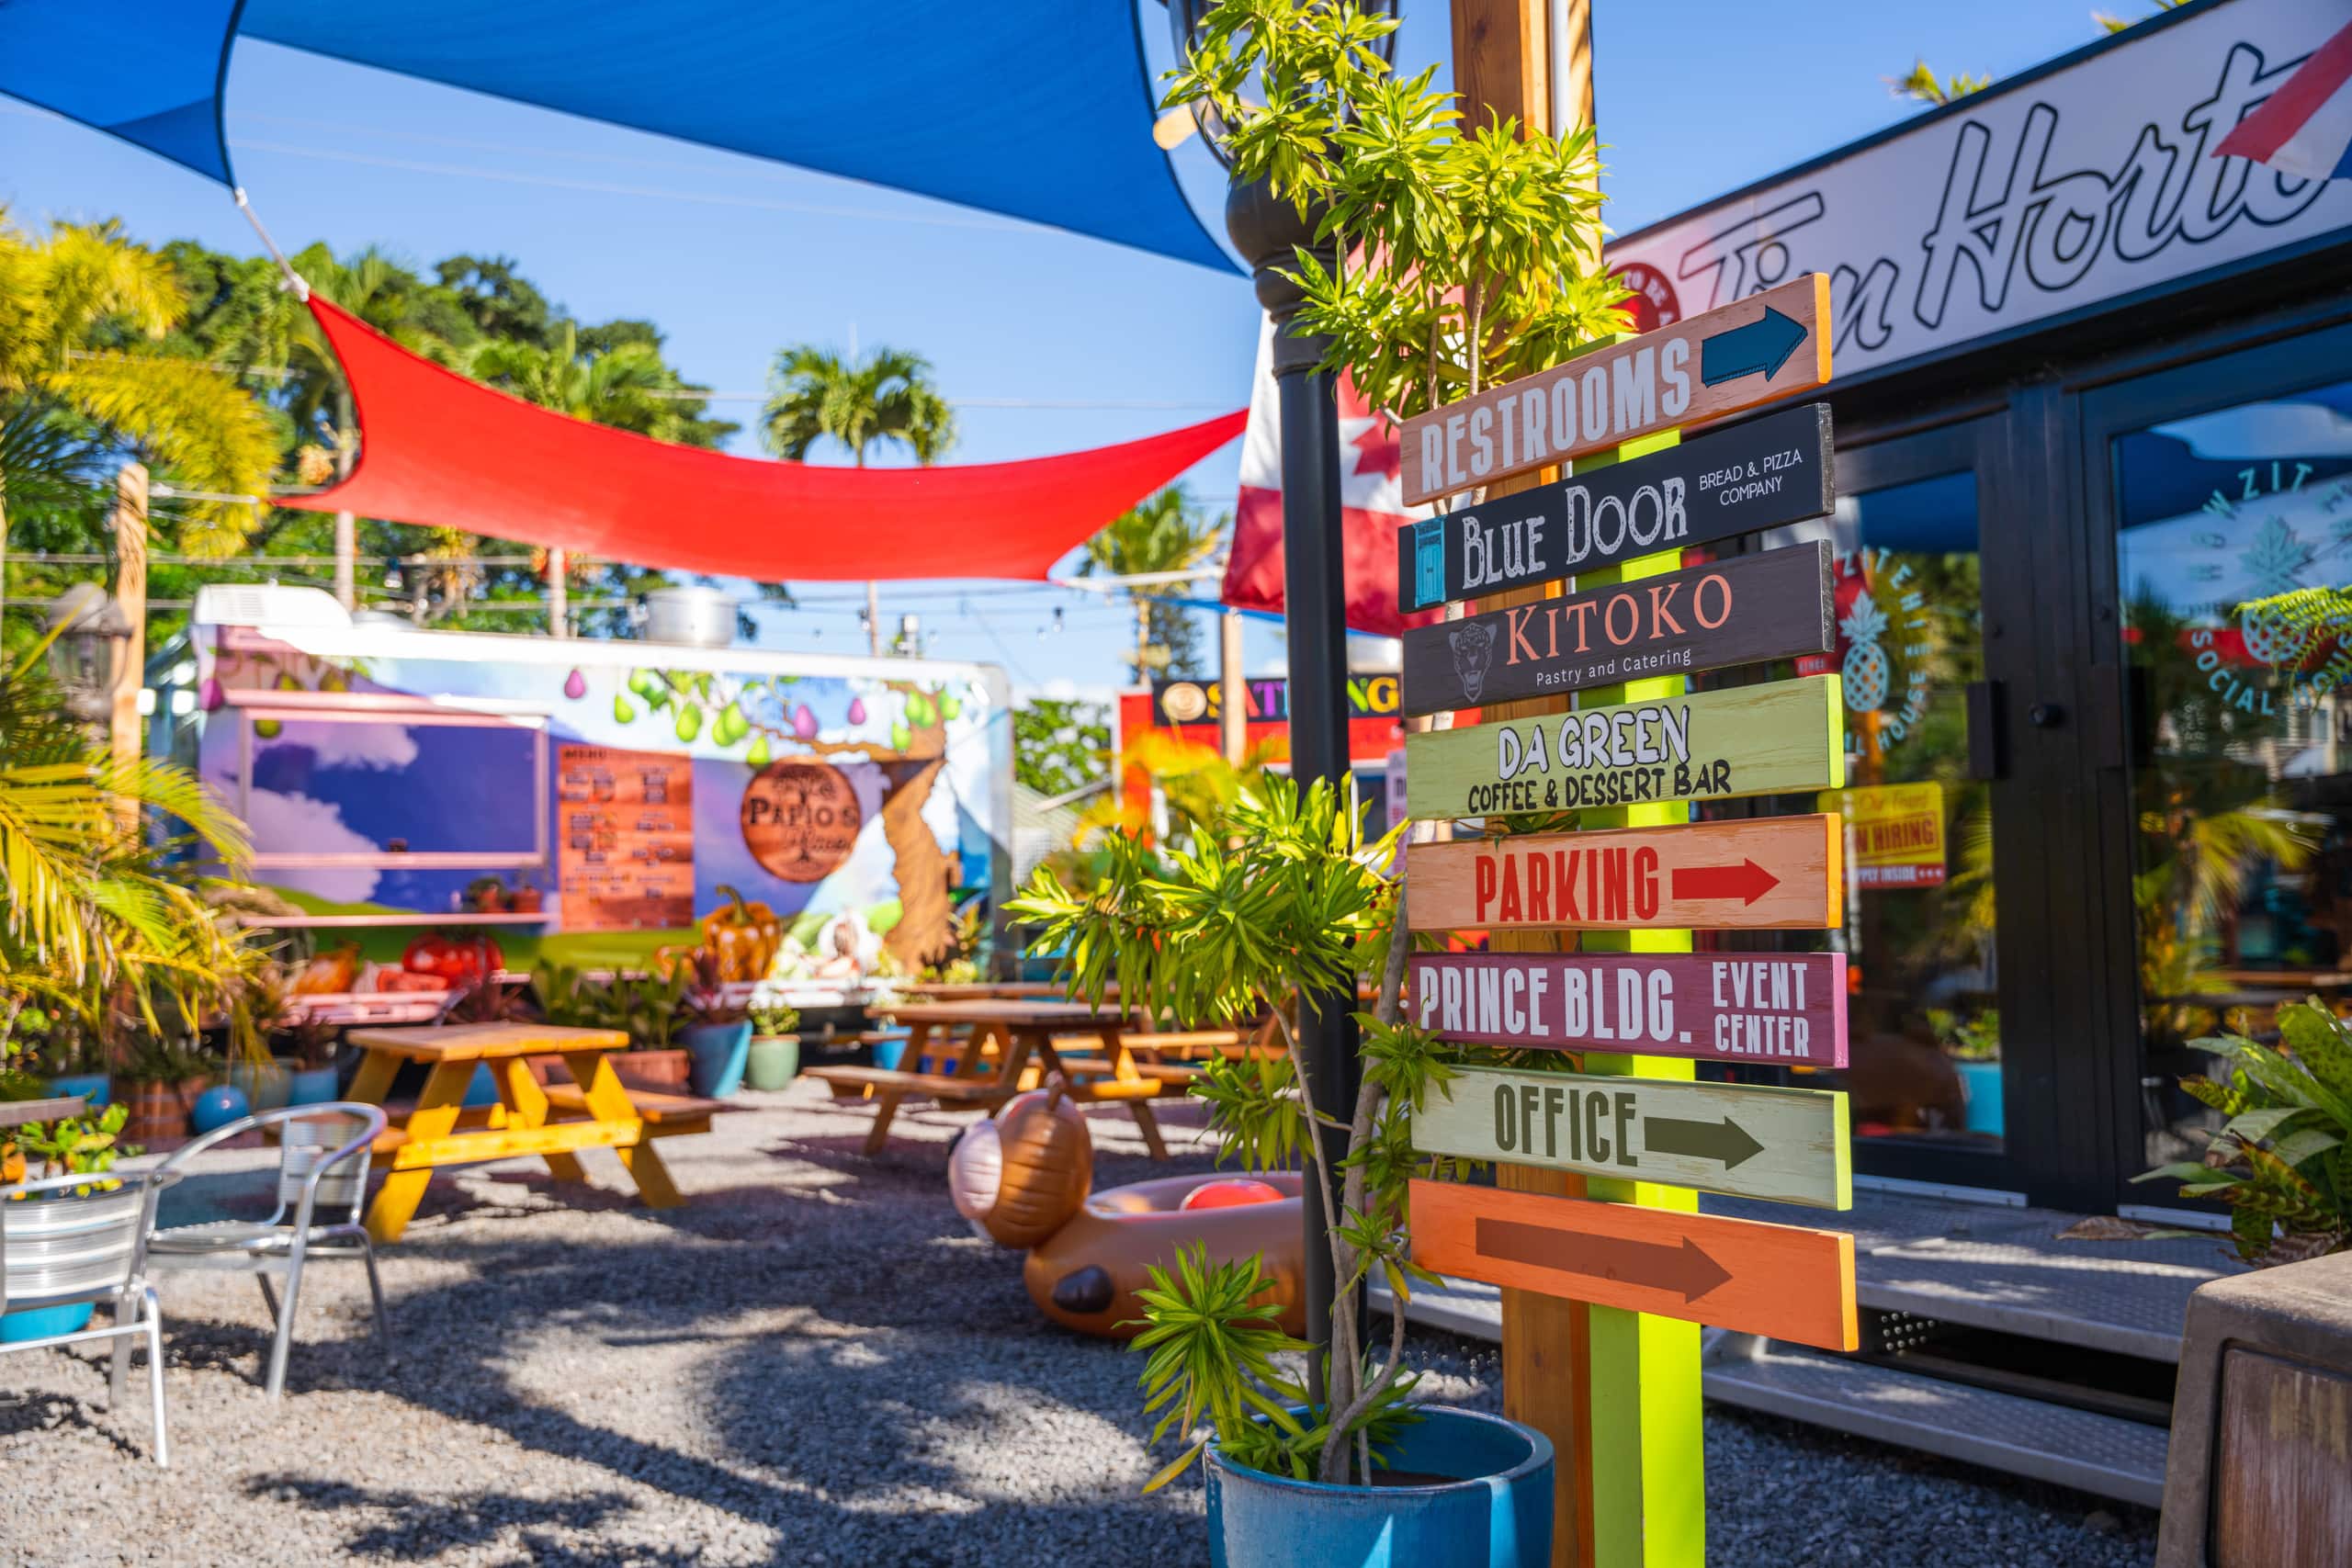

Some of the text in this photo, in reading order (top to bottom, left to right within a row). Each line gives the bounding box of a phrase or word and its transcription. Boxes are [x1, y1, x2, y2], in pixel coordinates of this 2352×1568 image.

[1420, 336, 1690, 494] RESTROOMS
[1699, 447, 1804, 491] BREAD & PIZZA
[1720, 475, 1783, 506] COMPANY
[1566, 475, 1689, 566] DOOR
[1504, 574, 1732, 665] KITOKO
[1536, 648, 1692, 687] Pastry and Catering
[2192, 631, 2276, 716] SOCIAL
[1498, 705, 1690, 781] DA GREEN
[1876, 671, 1927, 750] HOUSE
[1469, 759, 1732, 815] COFFEE & DESSERT BAR
[1873, 818, 1936, 852] HIRING
[1475, 846, 1659, 923] PARKING
[1419, 965, 1692, 1043] PRINCE BLDG.
[1712, 961, 1808, 1010] EVENT
[1714, 1013, 1810, 1058] CENTER
[1494, 1083, 1639, 1168] OFFICE
